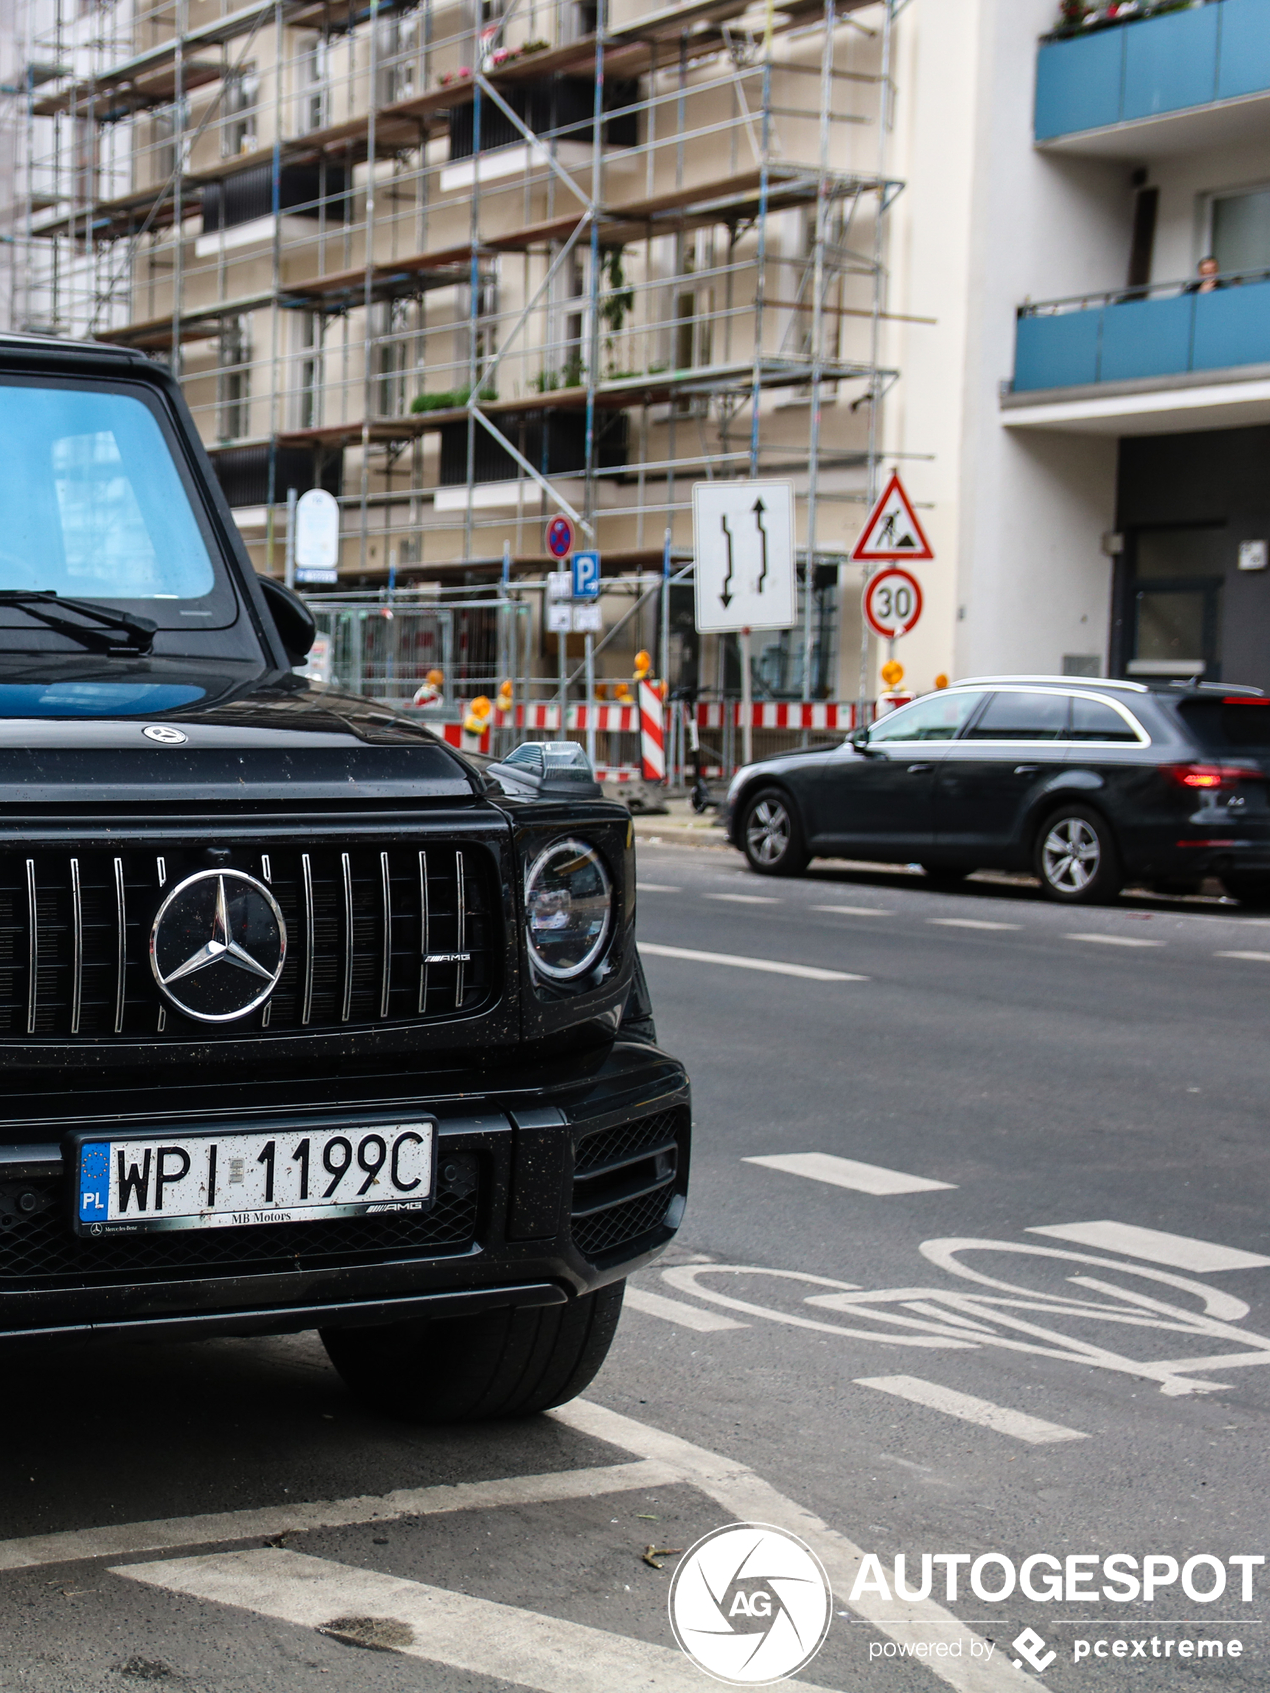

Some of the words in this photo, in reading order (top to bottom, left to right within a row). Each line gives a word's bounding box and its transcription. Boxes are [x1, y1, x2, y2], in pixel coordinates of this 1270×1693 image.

[577, 556, 595, 593] P
[877, 587, 911, 618] 30
[440, 954, 471, 962] AMG
[117, 1143, 217, 1213] WPI
[257, 1131, 424, 1202] 1199C
[82, 1192, 105, 1209] PL
[384, 1201, 422, 1212] AMG
[231, 1213, 250, 1225] MB
[253, 1211, 292, 1223] Motors
